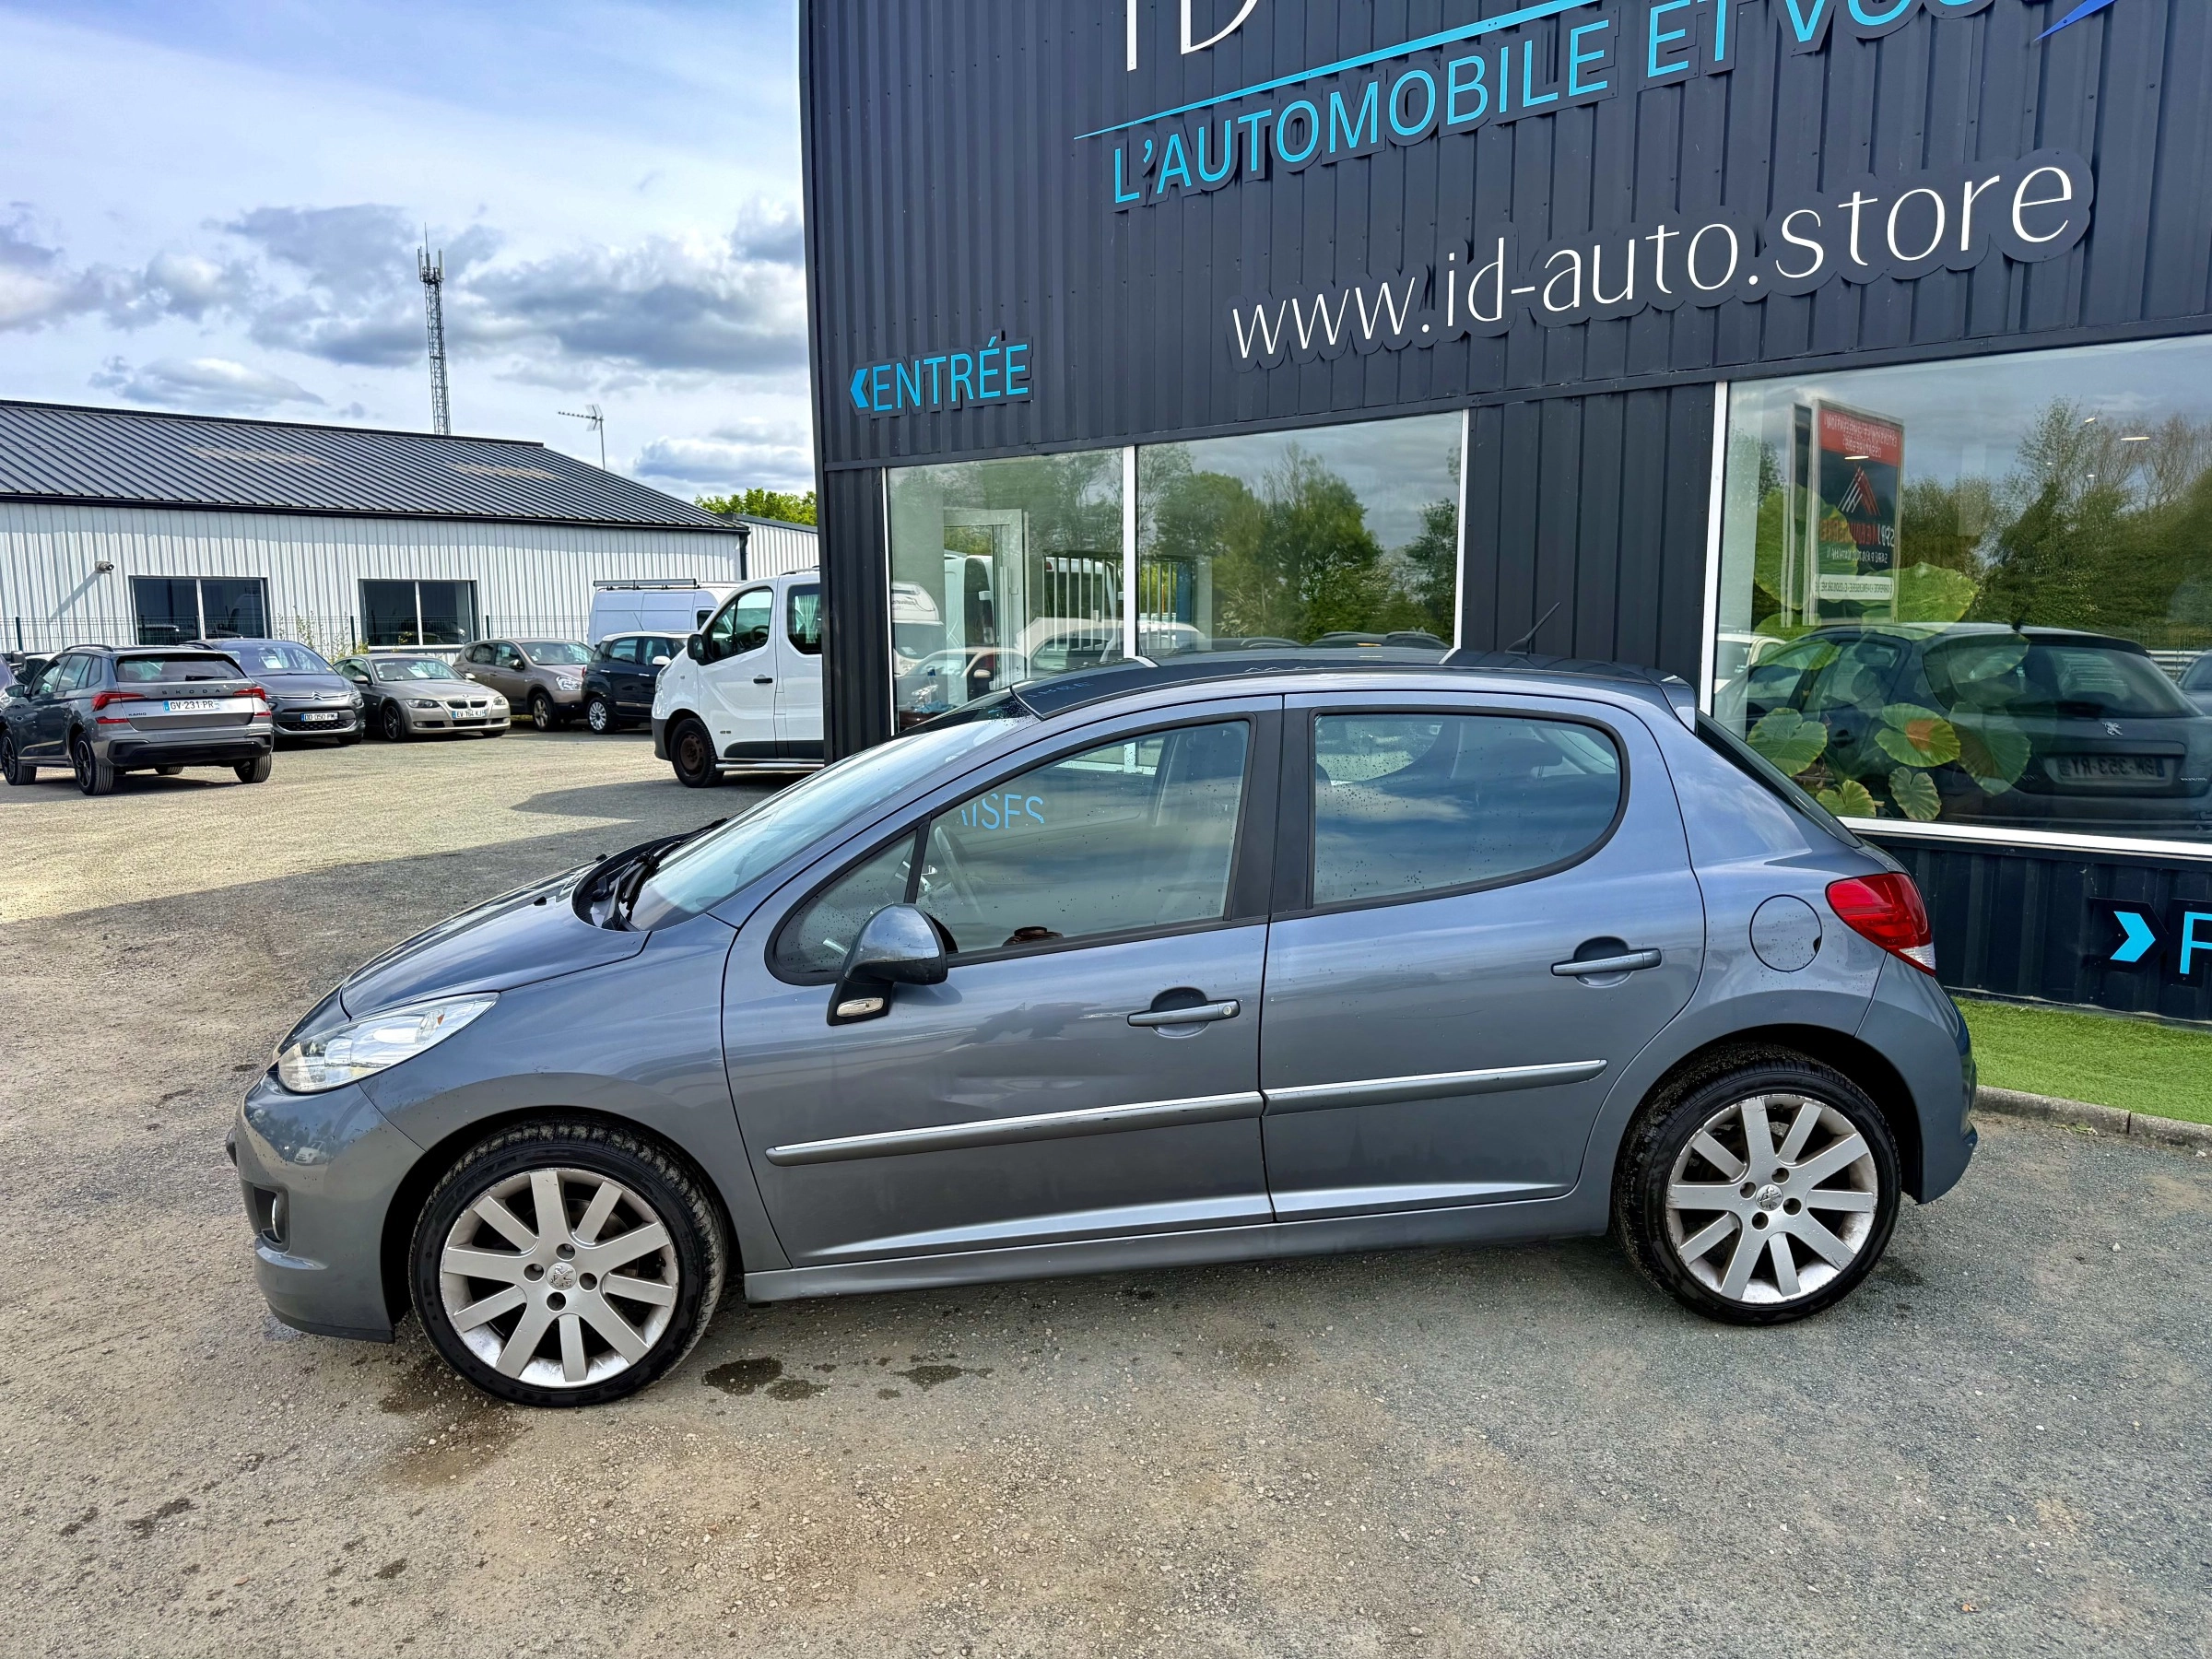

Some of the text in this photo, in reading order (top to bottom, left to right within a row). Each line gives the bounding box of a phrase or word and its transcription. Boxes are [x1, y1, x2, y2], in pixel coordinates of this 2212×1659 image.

[1113, 18, 1610, 205] L'AUTOMOBILE
[1647, 0, 1728, 78] ET
[1232, 166, 2073, 359] www.id-auto.store
[871, 335, 1029, 412] ENTRÉE
